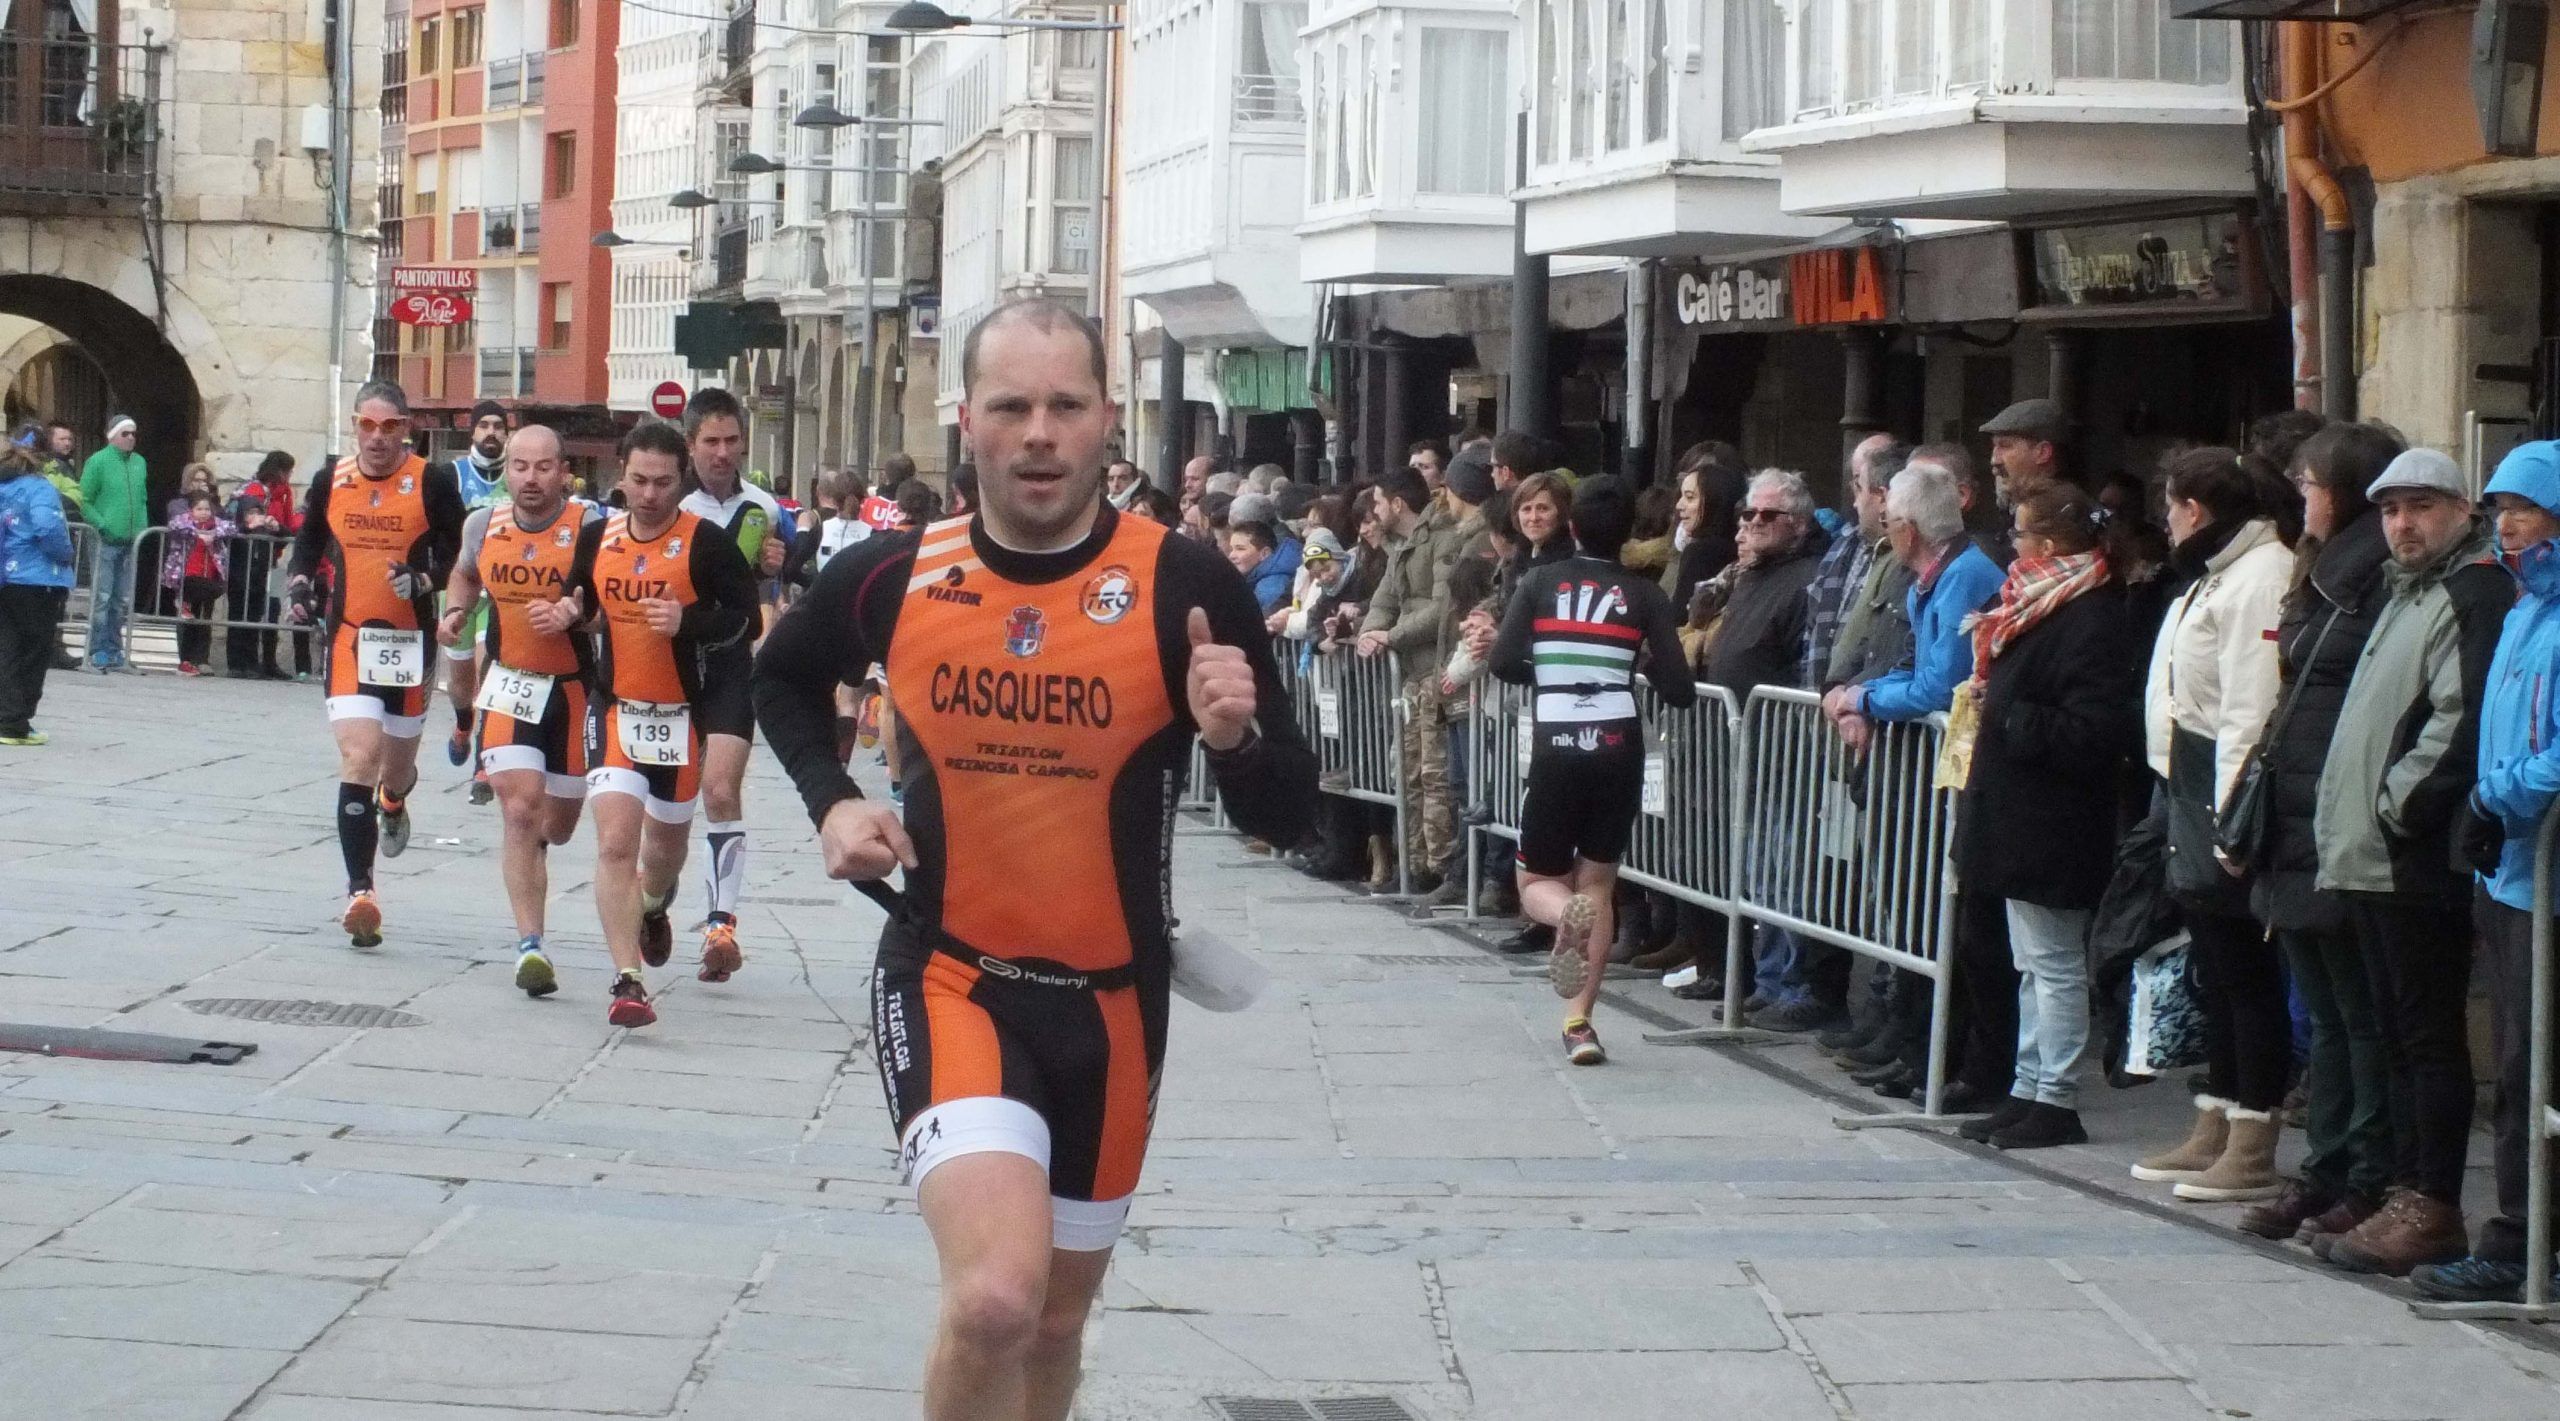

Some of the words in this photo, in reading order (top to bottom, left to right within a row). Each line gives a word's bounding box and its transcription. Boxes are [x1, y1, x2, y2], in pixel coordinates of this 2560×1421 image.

[394, 270, 471, 287] PANTORTILLAS
[1678, 267, 1732, 324] Café
[1738, 270, 1782, 319] Bar
[490, 563, 564, 586] MOYA
[605, 577, 667, 602] RUIZ
[362, 631, 418, 644] Liberbank
[379, 649, 402, 666] 55
[501, 676, 534, 699] 135
[930, 662, 1113, 729] CASQUERO
[621, 702, 684, 718] Liberbank
[632, 724, 671, 742] 139
[1025, 971, 1088, 989] Kalenji
